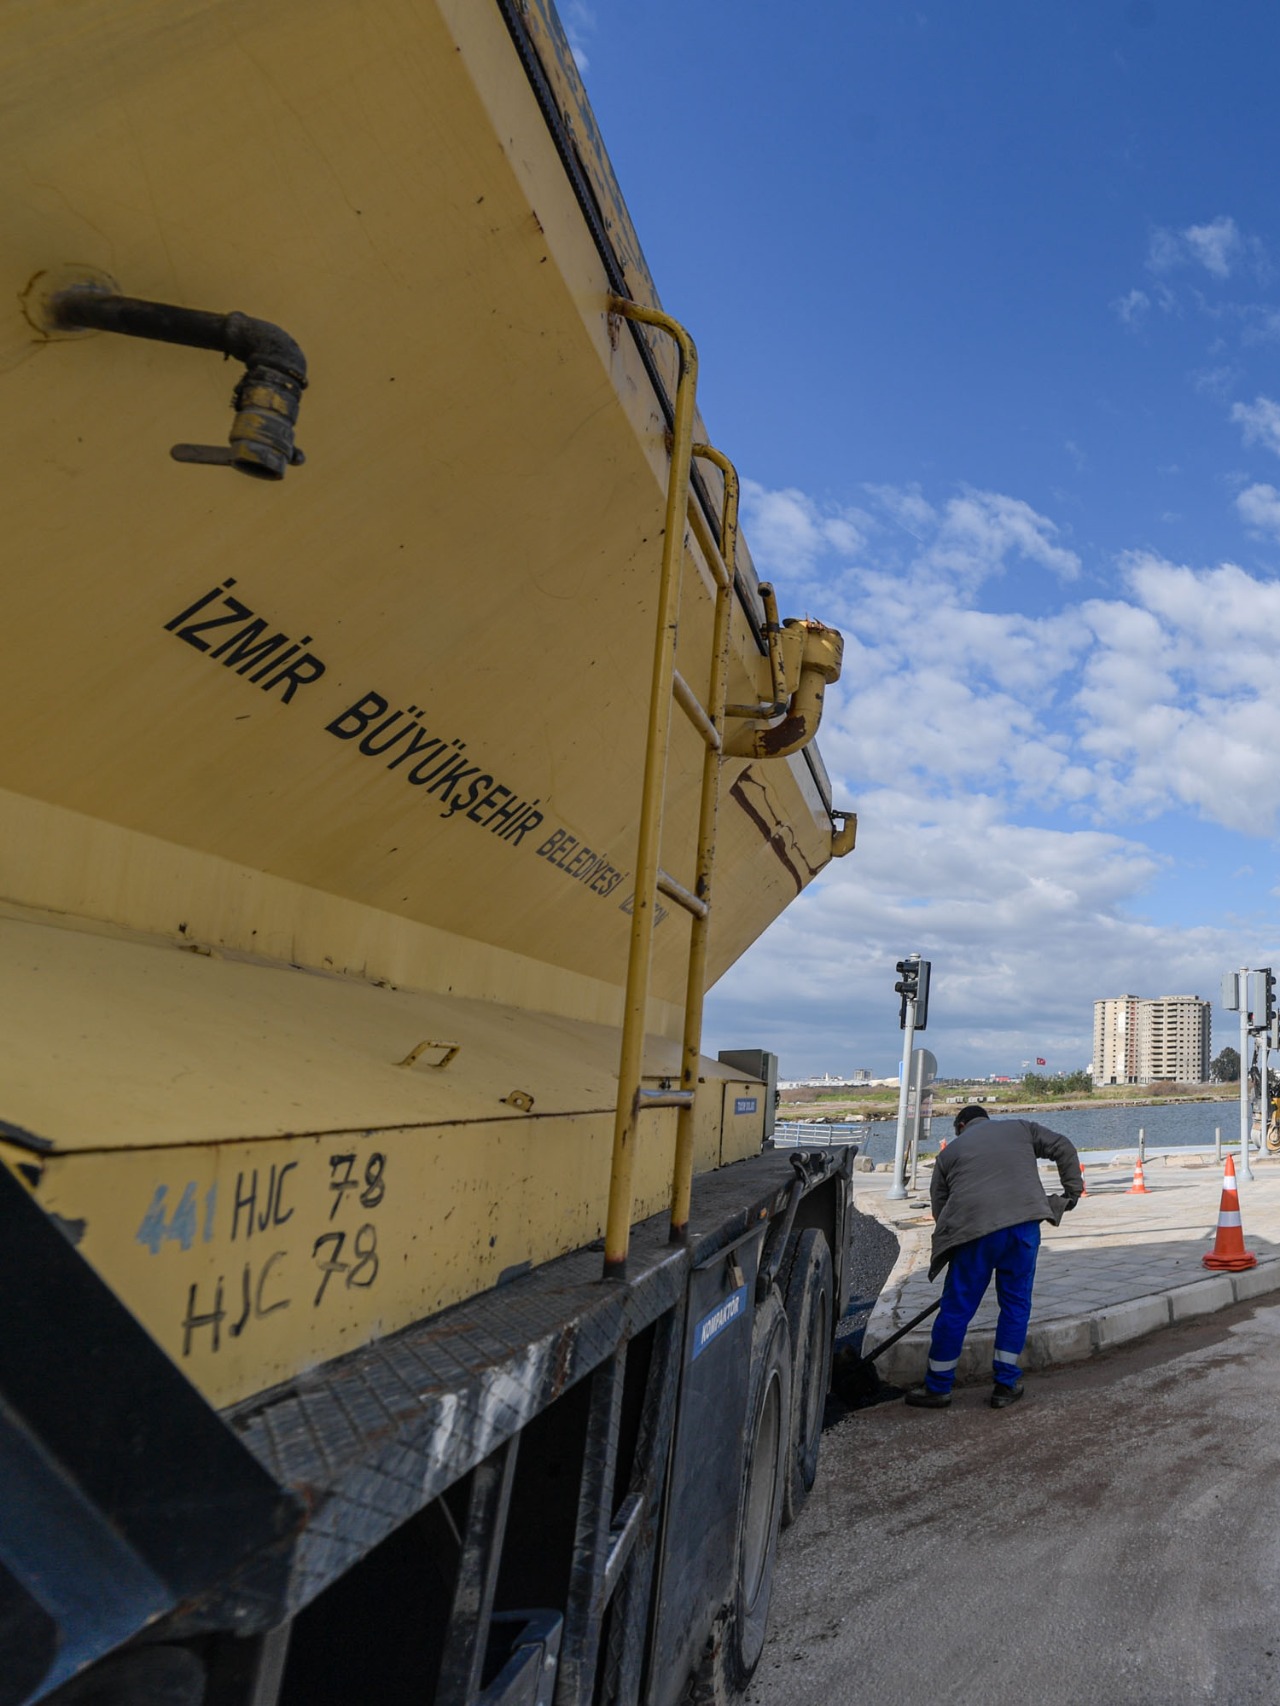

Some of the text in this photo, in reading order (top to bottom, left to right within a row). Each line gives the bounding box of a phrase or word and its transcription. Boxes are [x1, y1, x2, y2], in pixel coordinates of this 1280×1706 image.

[163, 577, 326, 705] İZMİR
[324, 691, 544, 847] BÜYÜKŞEHİR
[535, 828, 631, 898] BELEDİYESİ
[328, 1152, 387, 1221] 78
[312, 1222, 379, 1308] 78
[701, 1294, 740, 1345] KOMPAKTÖR
